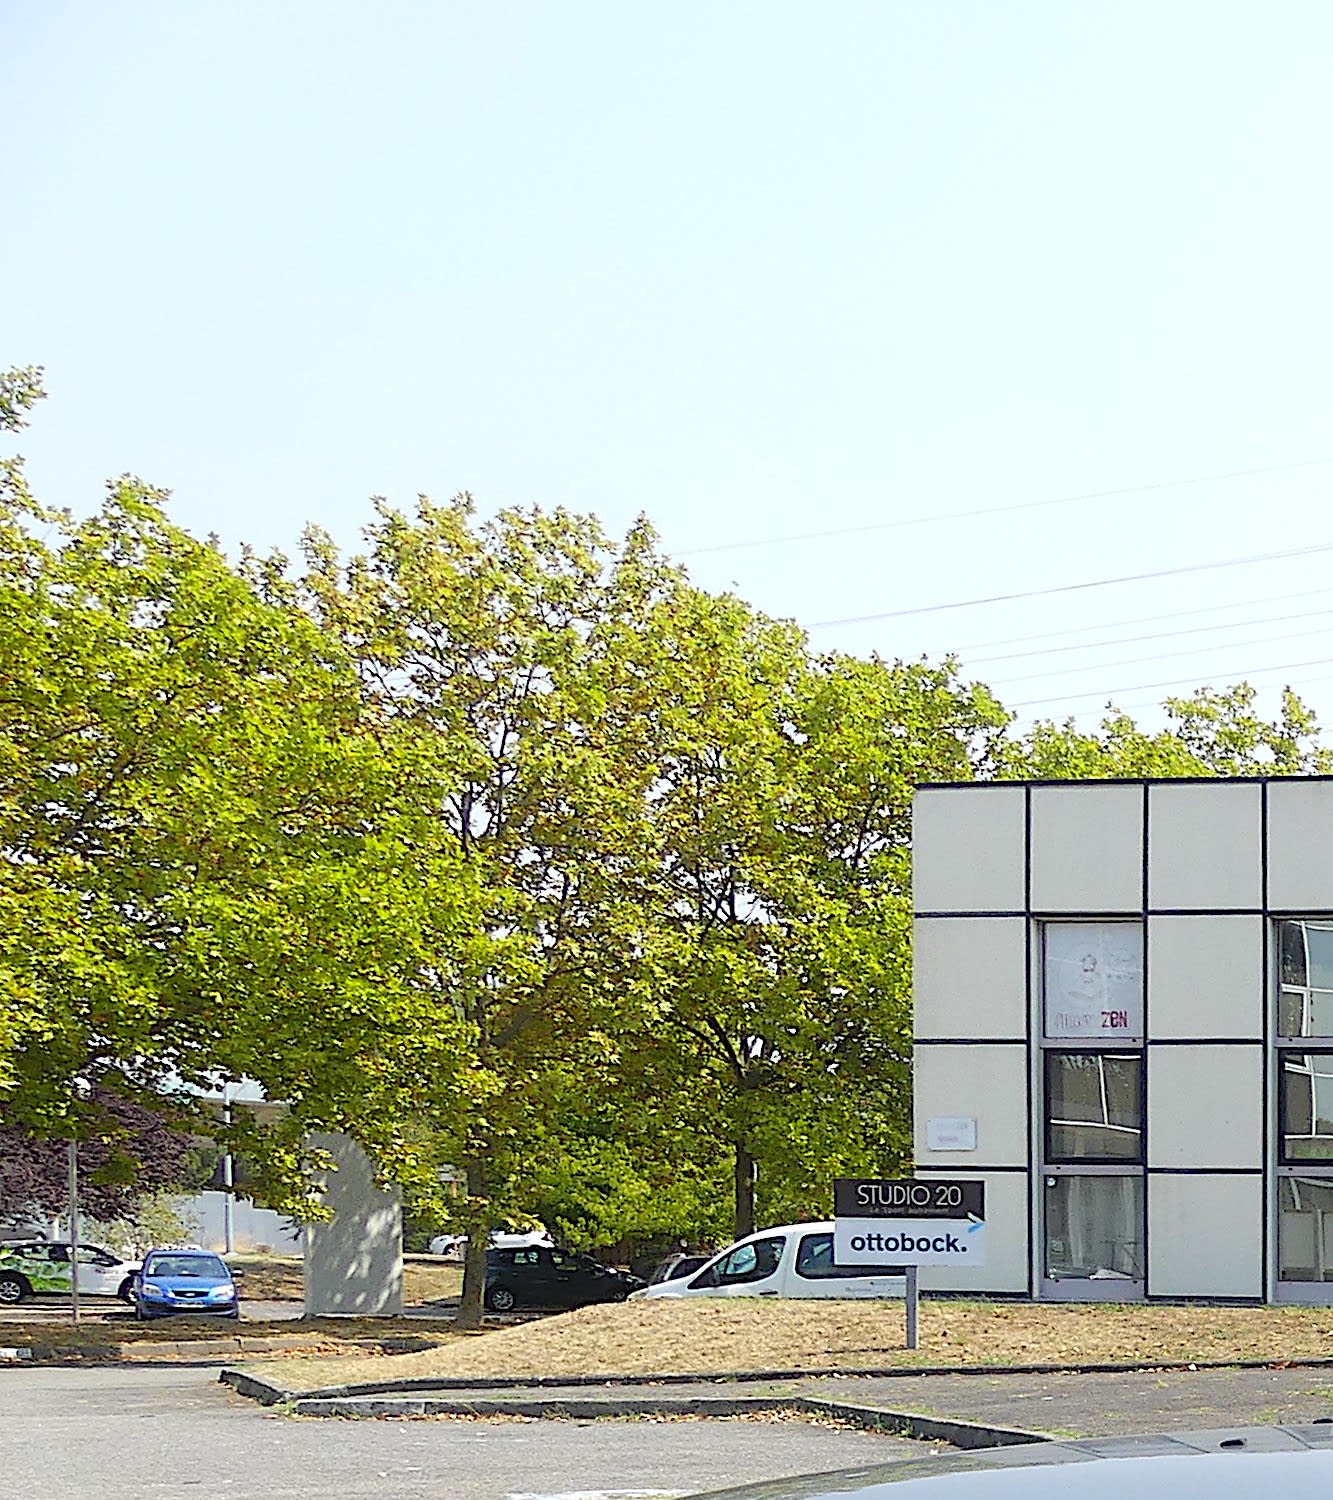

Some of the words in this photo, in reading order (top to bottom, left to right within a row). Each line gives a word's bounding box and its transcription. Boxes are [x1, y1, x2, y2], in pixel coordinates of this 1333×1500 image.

[857, 1184, 931, 1206] STUDIO
[935, 1185, 962, 1206] 20
[851, 1233, 968, 1253] ottobock.
